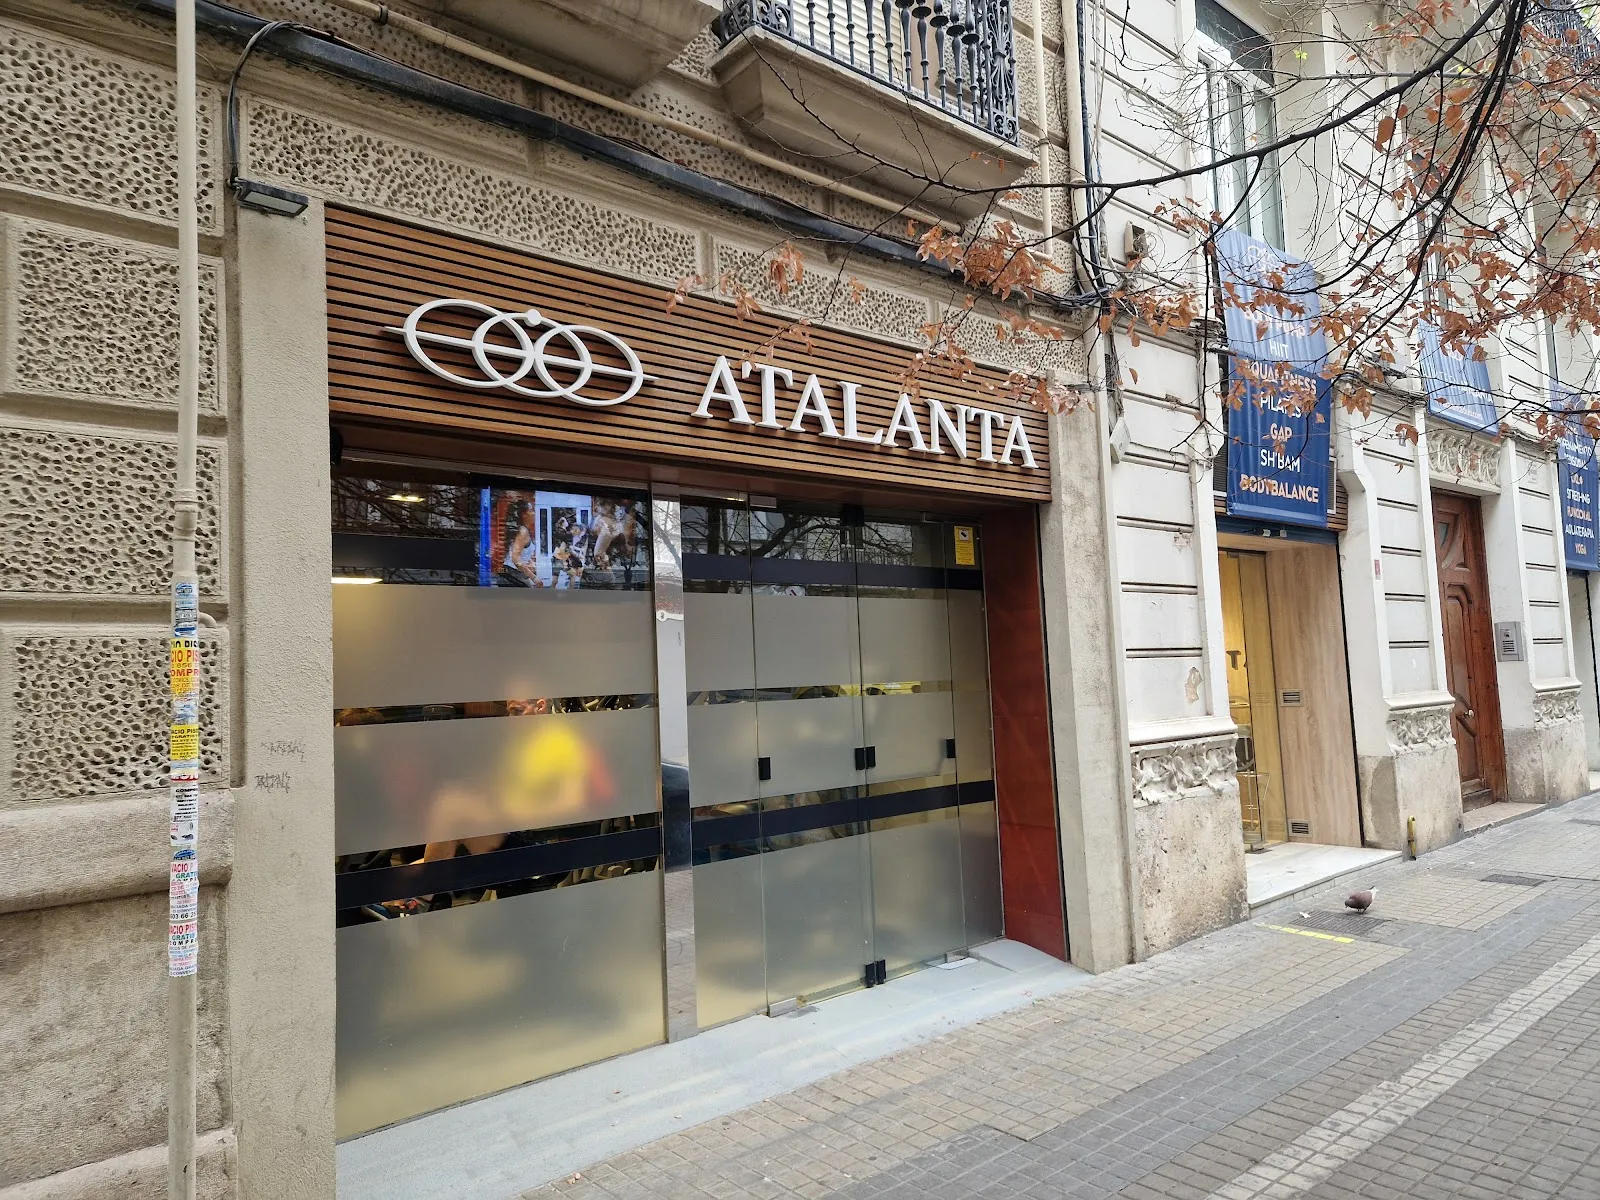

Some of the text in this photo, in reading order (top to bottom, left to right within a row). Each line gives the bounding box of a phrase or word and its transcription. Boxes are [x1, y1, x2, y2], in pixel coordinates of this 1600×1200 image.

[1269, 339, 1289, 359] HIIT
[691, 355, 1040, 470] ATALANTA
[1270, 422, 1293, 443] GAP
[1260, 448, 1301, 473] SH'BAM
